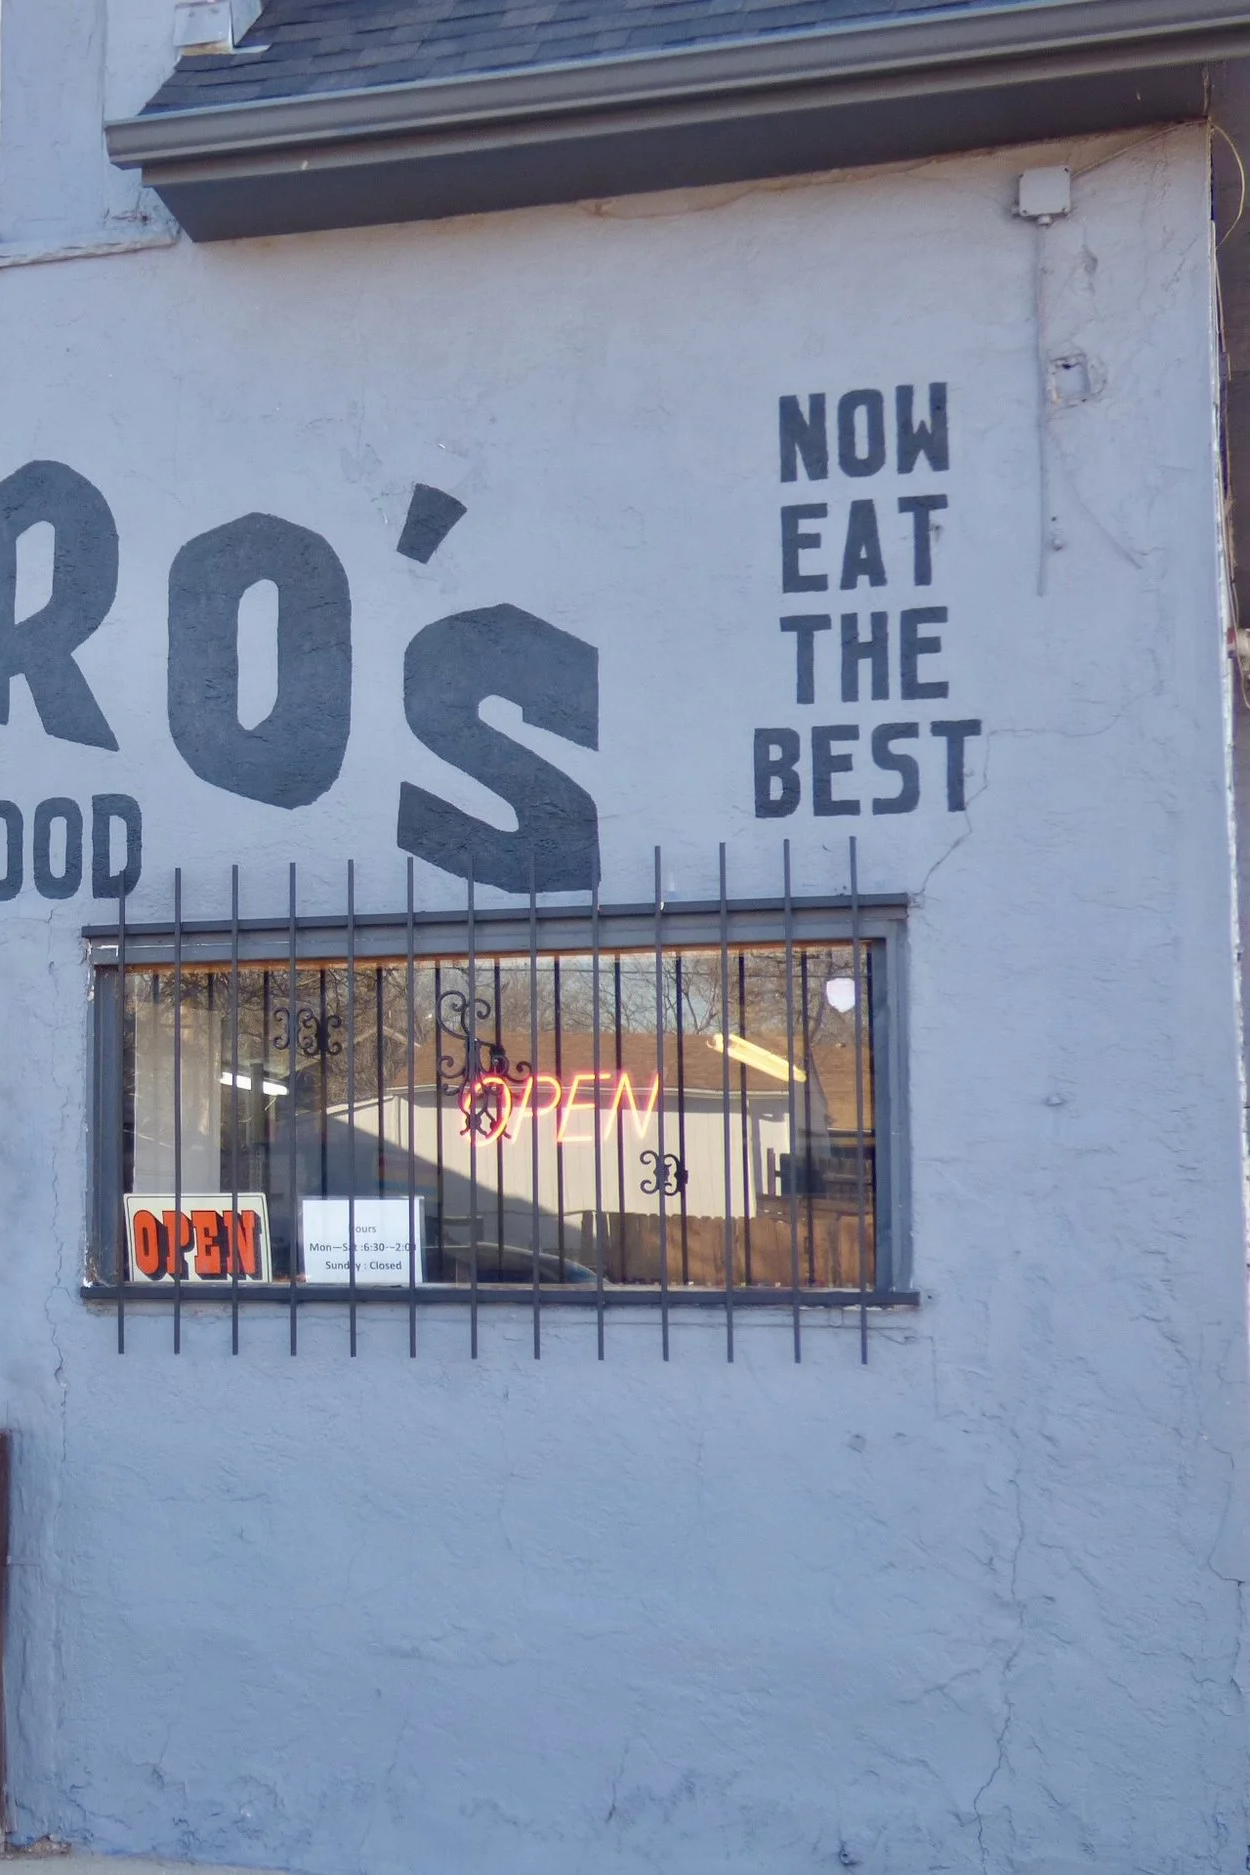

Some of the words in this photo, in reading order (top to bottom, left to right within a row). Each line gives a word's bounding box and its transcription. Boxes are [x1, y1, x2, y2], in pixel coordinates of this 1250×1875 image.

[779, 382, 949, 482] NOW
[781, 494, 948, 593] EAT
[780, 606, 949, 704] THE
[754, 719, 982, 818] BEST
[465, 1071, 660, 1148] OPEN
[133, 1210, 261, 1280] OPEN
[325, 1261, 362, 1271] Sundy
[369, 1260, 403, 1270] Closed
[352, 1225, 377, 1233] ours
